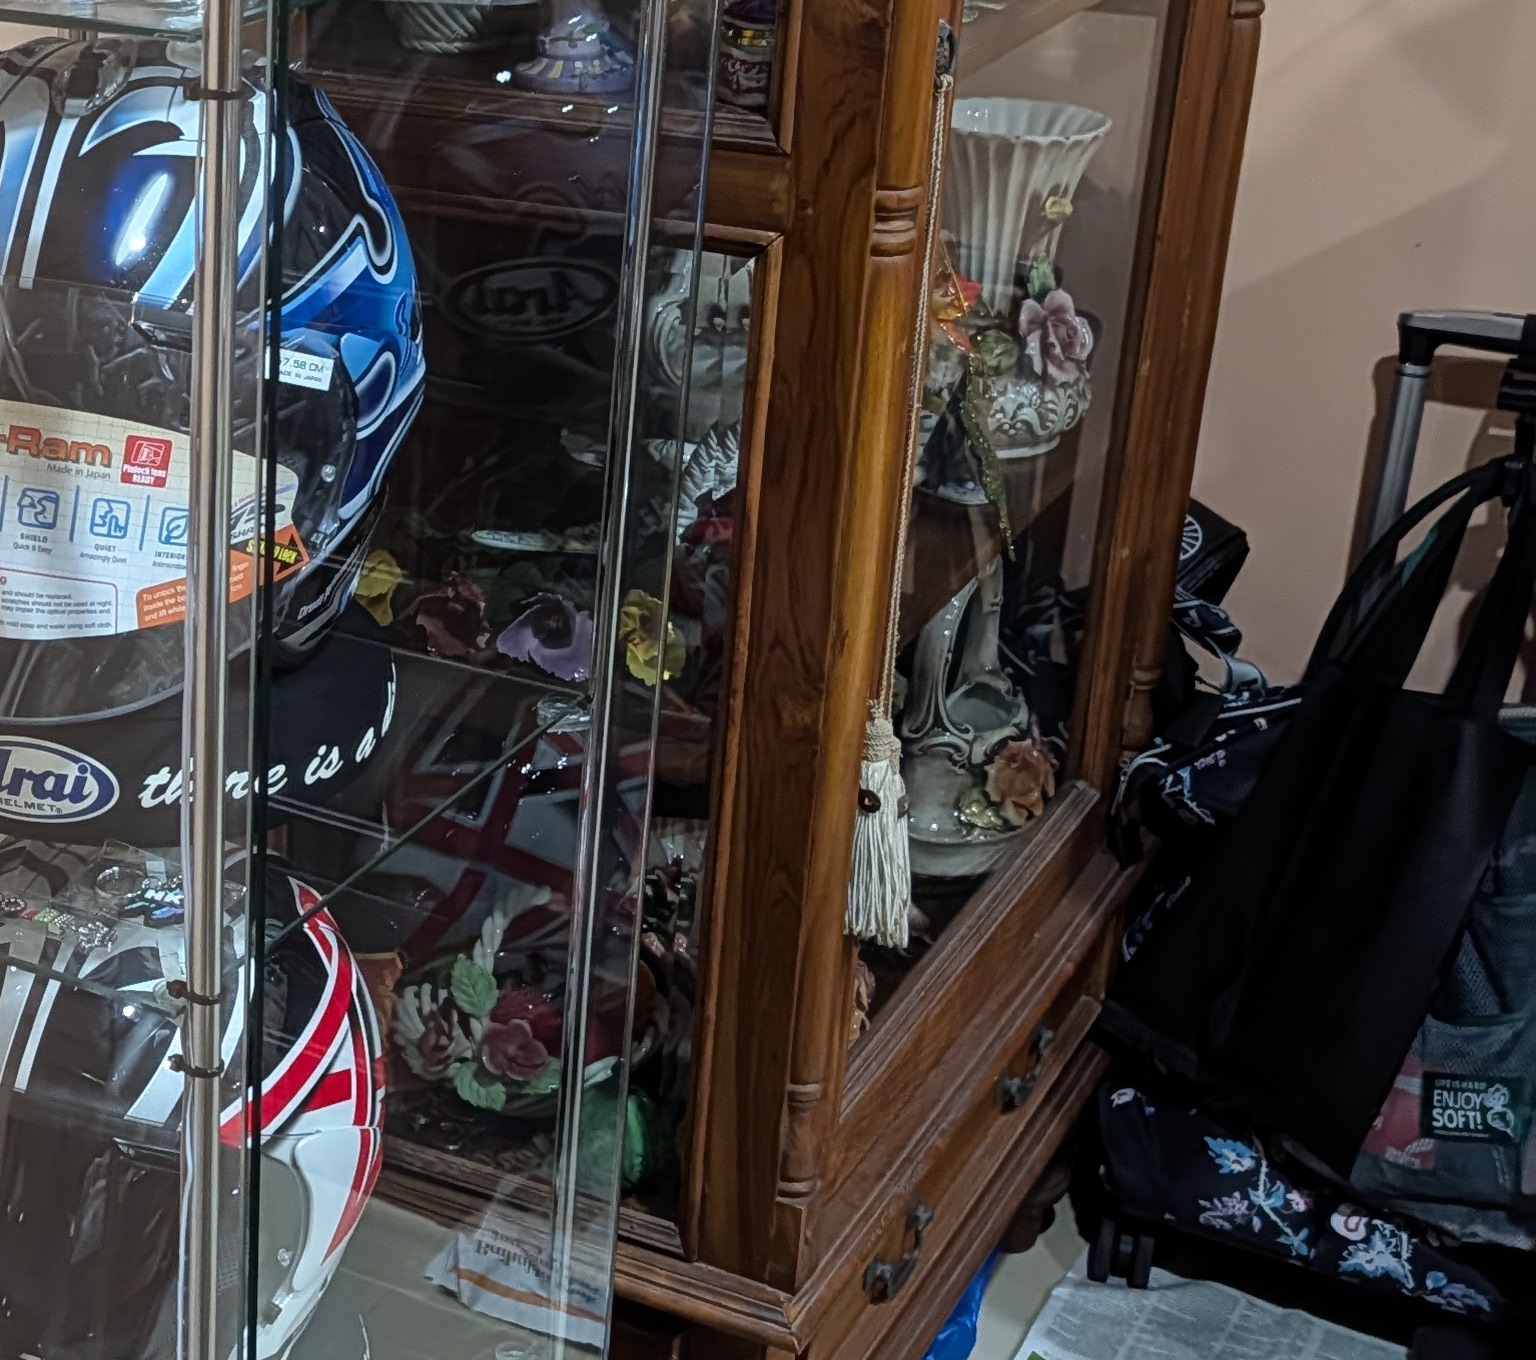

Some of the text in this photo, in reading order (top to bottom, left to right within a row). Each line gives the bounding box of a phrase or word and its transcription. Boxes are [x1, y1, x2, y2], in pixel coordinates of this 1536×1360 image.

[309, 363, 324, 374] CM
[46, 463, 111, 481] Made in Japan
[20, 532, 48, 543] SHIELD
[94, 543, 116, 552] QUIET
[304, 744, 344, 786] is
[1433, 1090, 1484, 1111] ENJOY
[1432, 1108, 1484, 1130] SOFT!
